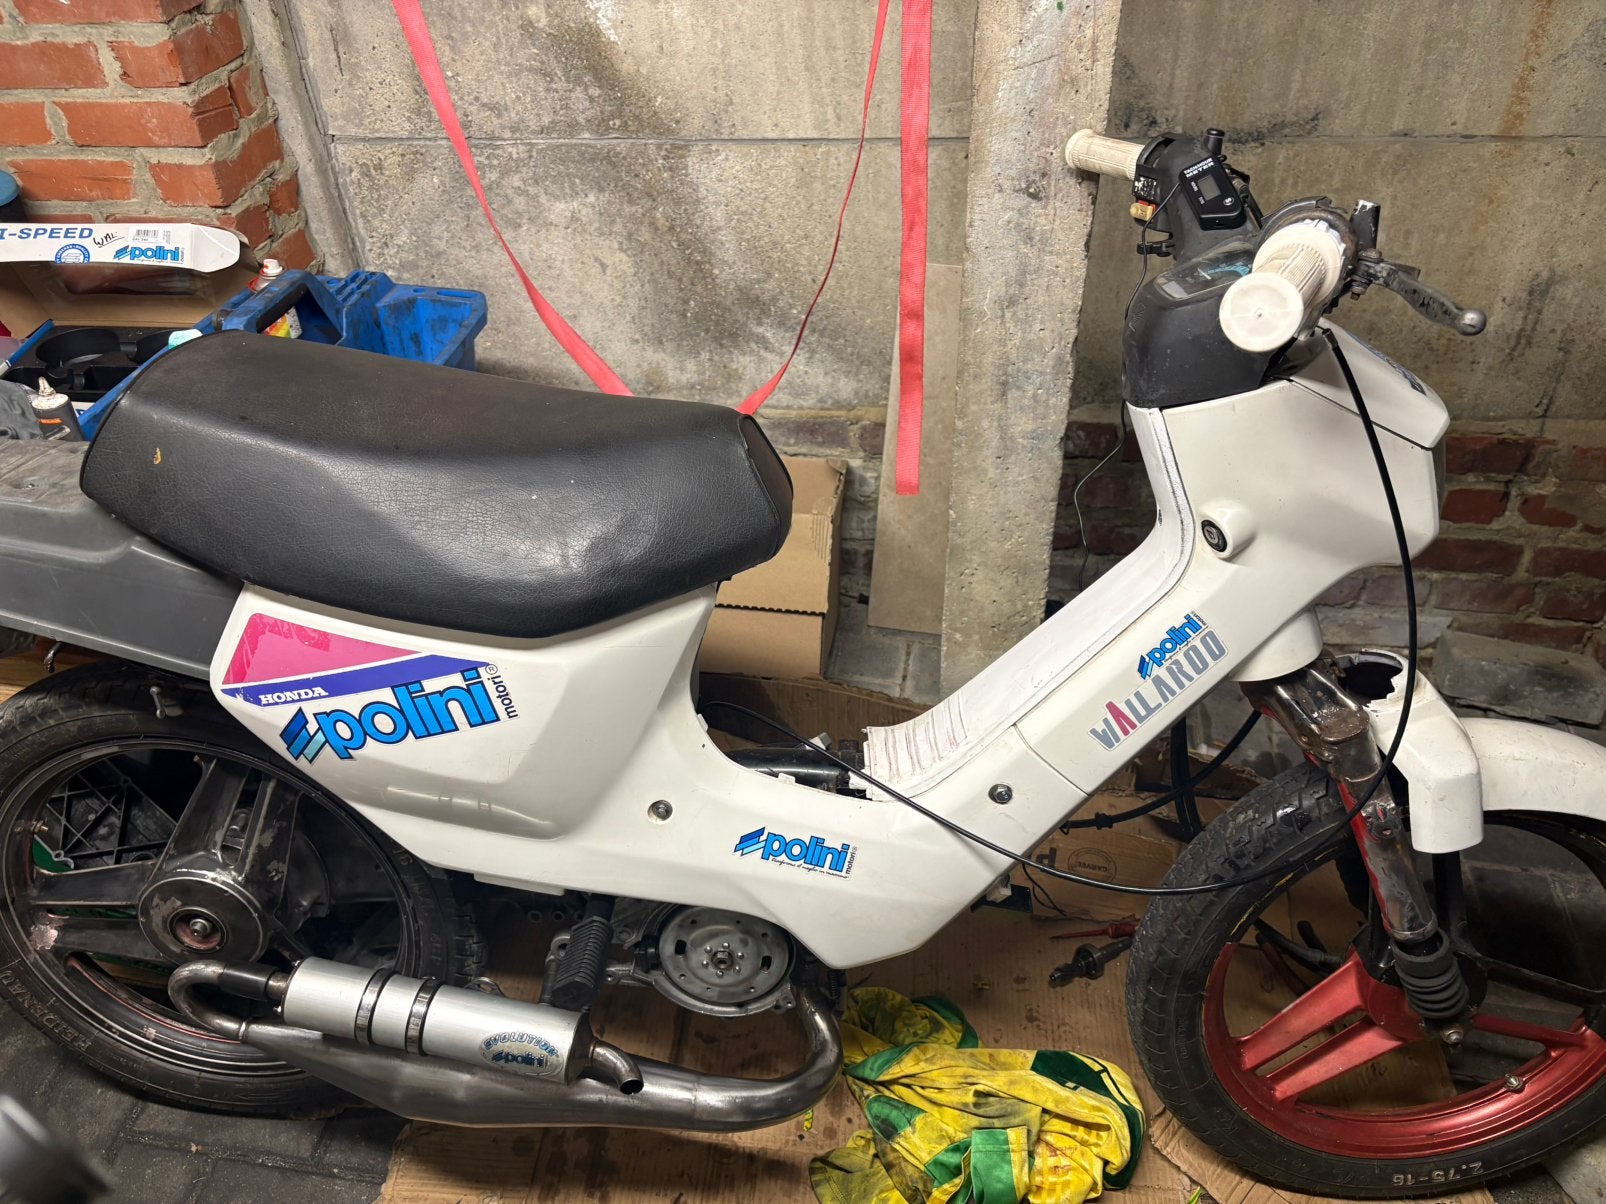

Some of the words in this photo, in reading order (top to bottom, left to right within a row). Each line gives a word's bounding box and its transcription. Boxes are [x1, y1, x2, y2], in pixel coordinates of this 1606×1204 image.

[130, 245, 180, 261] polini
[1146, 613, 1203, 667] polini
[258, 686, 329, 706] HONDA
[1089, 630, 1227, 749] WALLAROO
[314, 666, 501, 760] polini
[761, 832, 851, 873] polini
[0, 969, 92, 1051] HEIDENAU
[484, 1031, 558, 1057] EVOLUTION
[1392, 1161, 1484, 1187] 2.75-16
